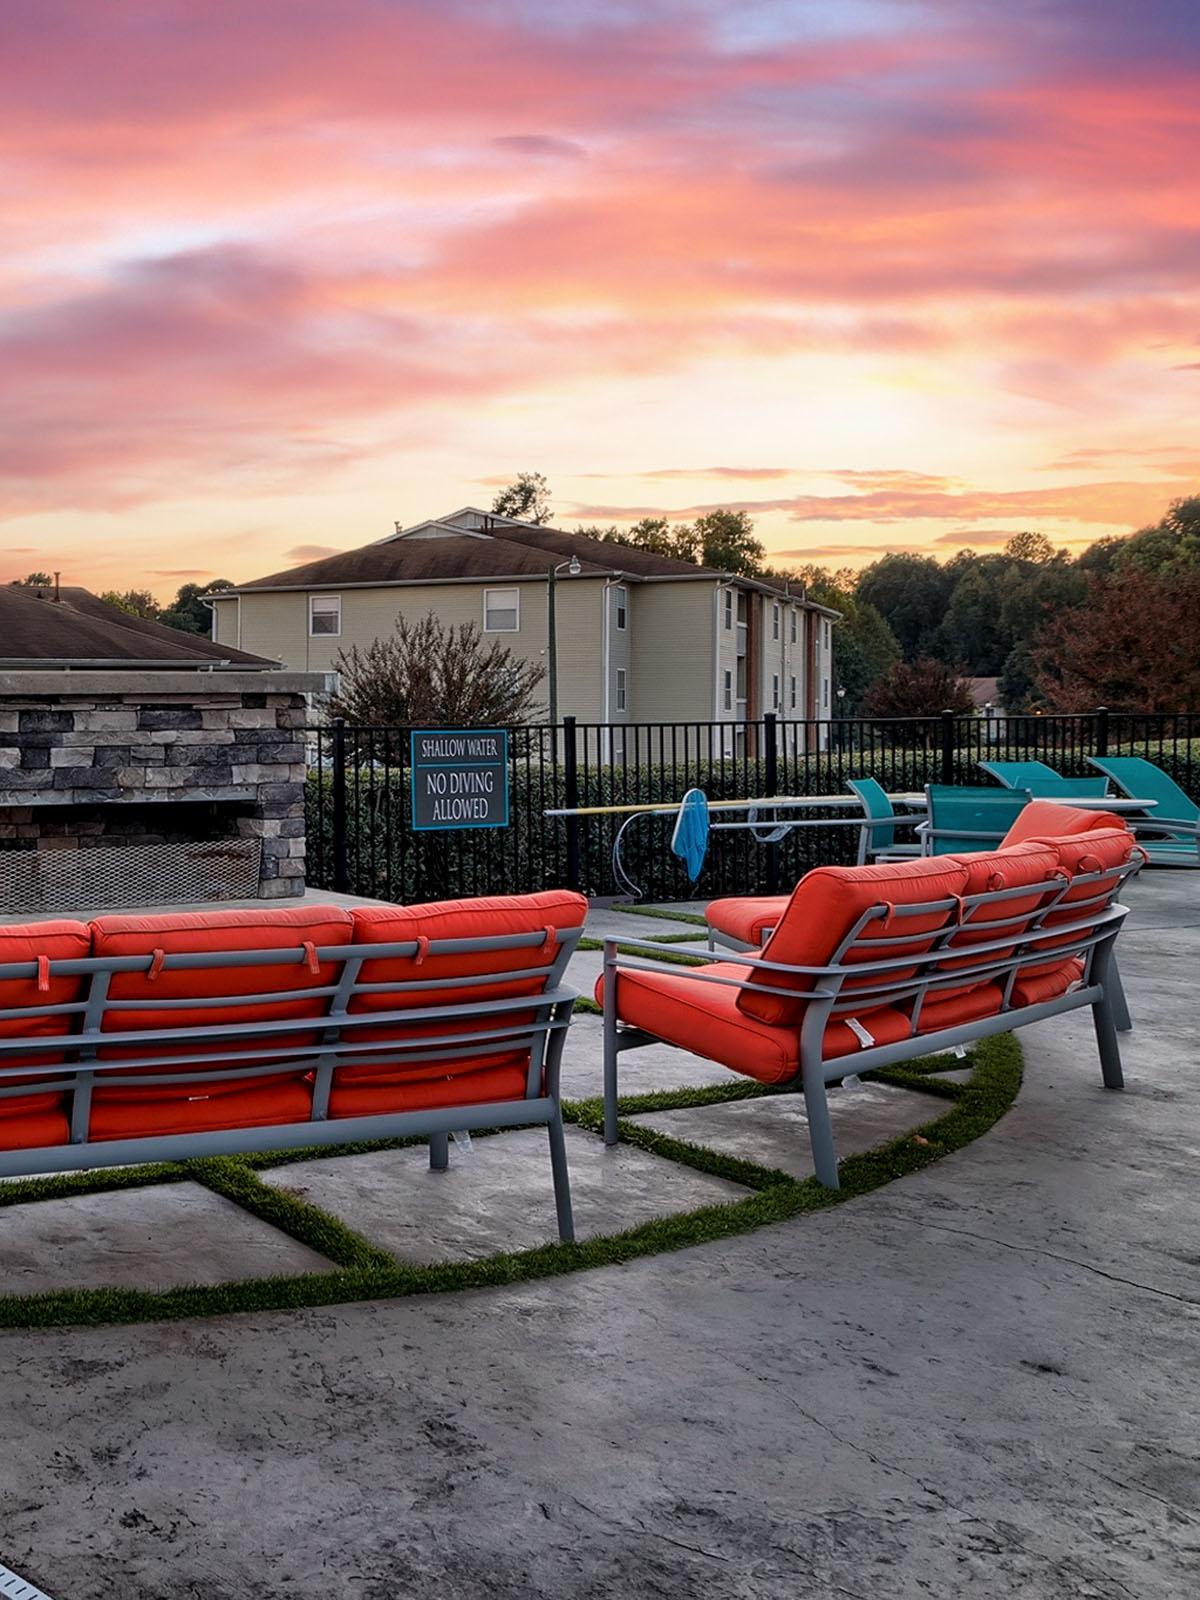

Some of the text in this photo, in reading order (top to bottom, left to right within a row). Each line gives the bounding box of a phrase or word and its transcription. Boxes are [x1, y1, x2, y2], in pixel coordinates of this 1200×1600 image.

[421, 739, 498, 757] SHALLOW WATER
[427, 771, 494, 795] NO DIVING
[432, 798, 489, 820] ALLOWED
